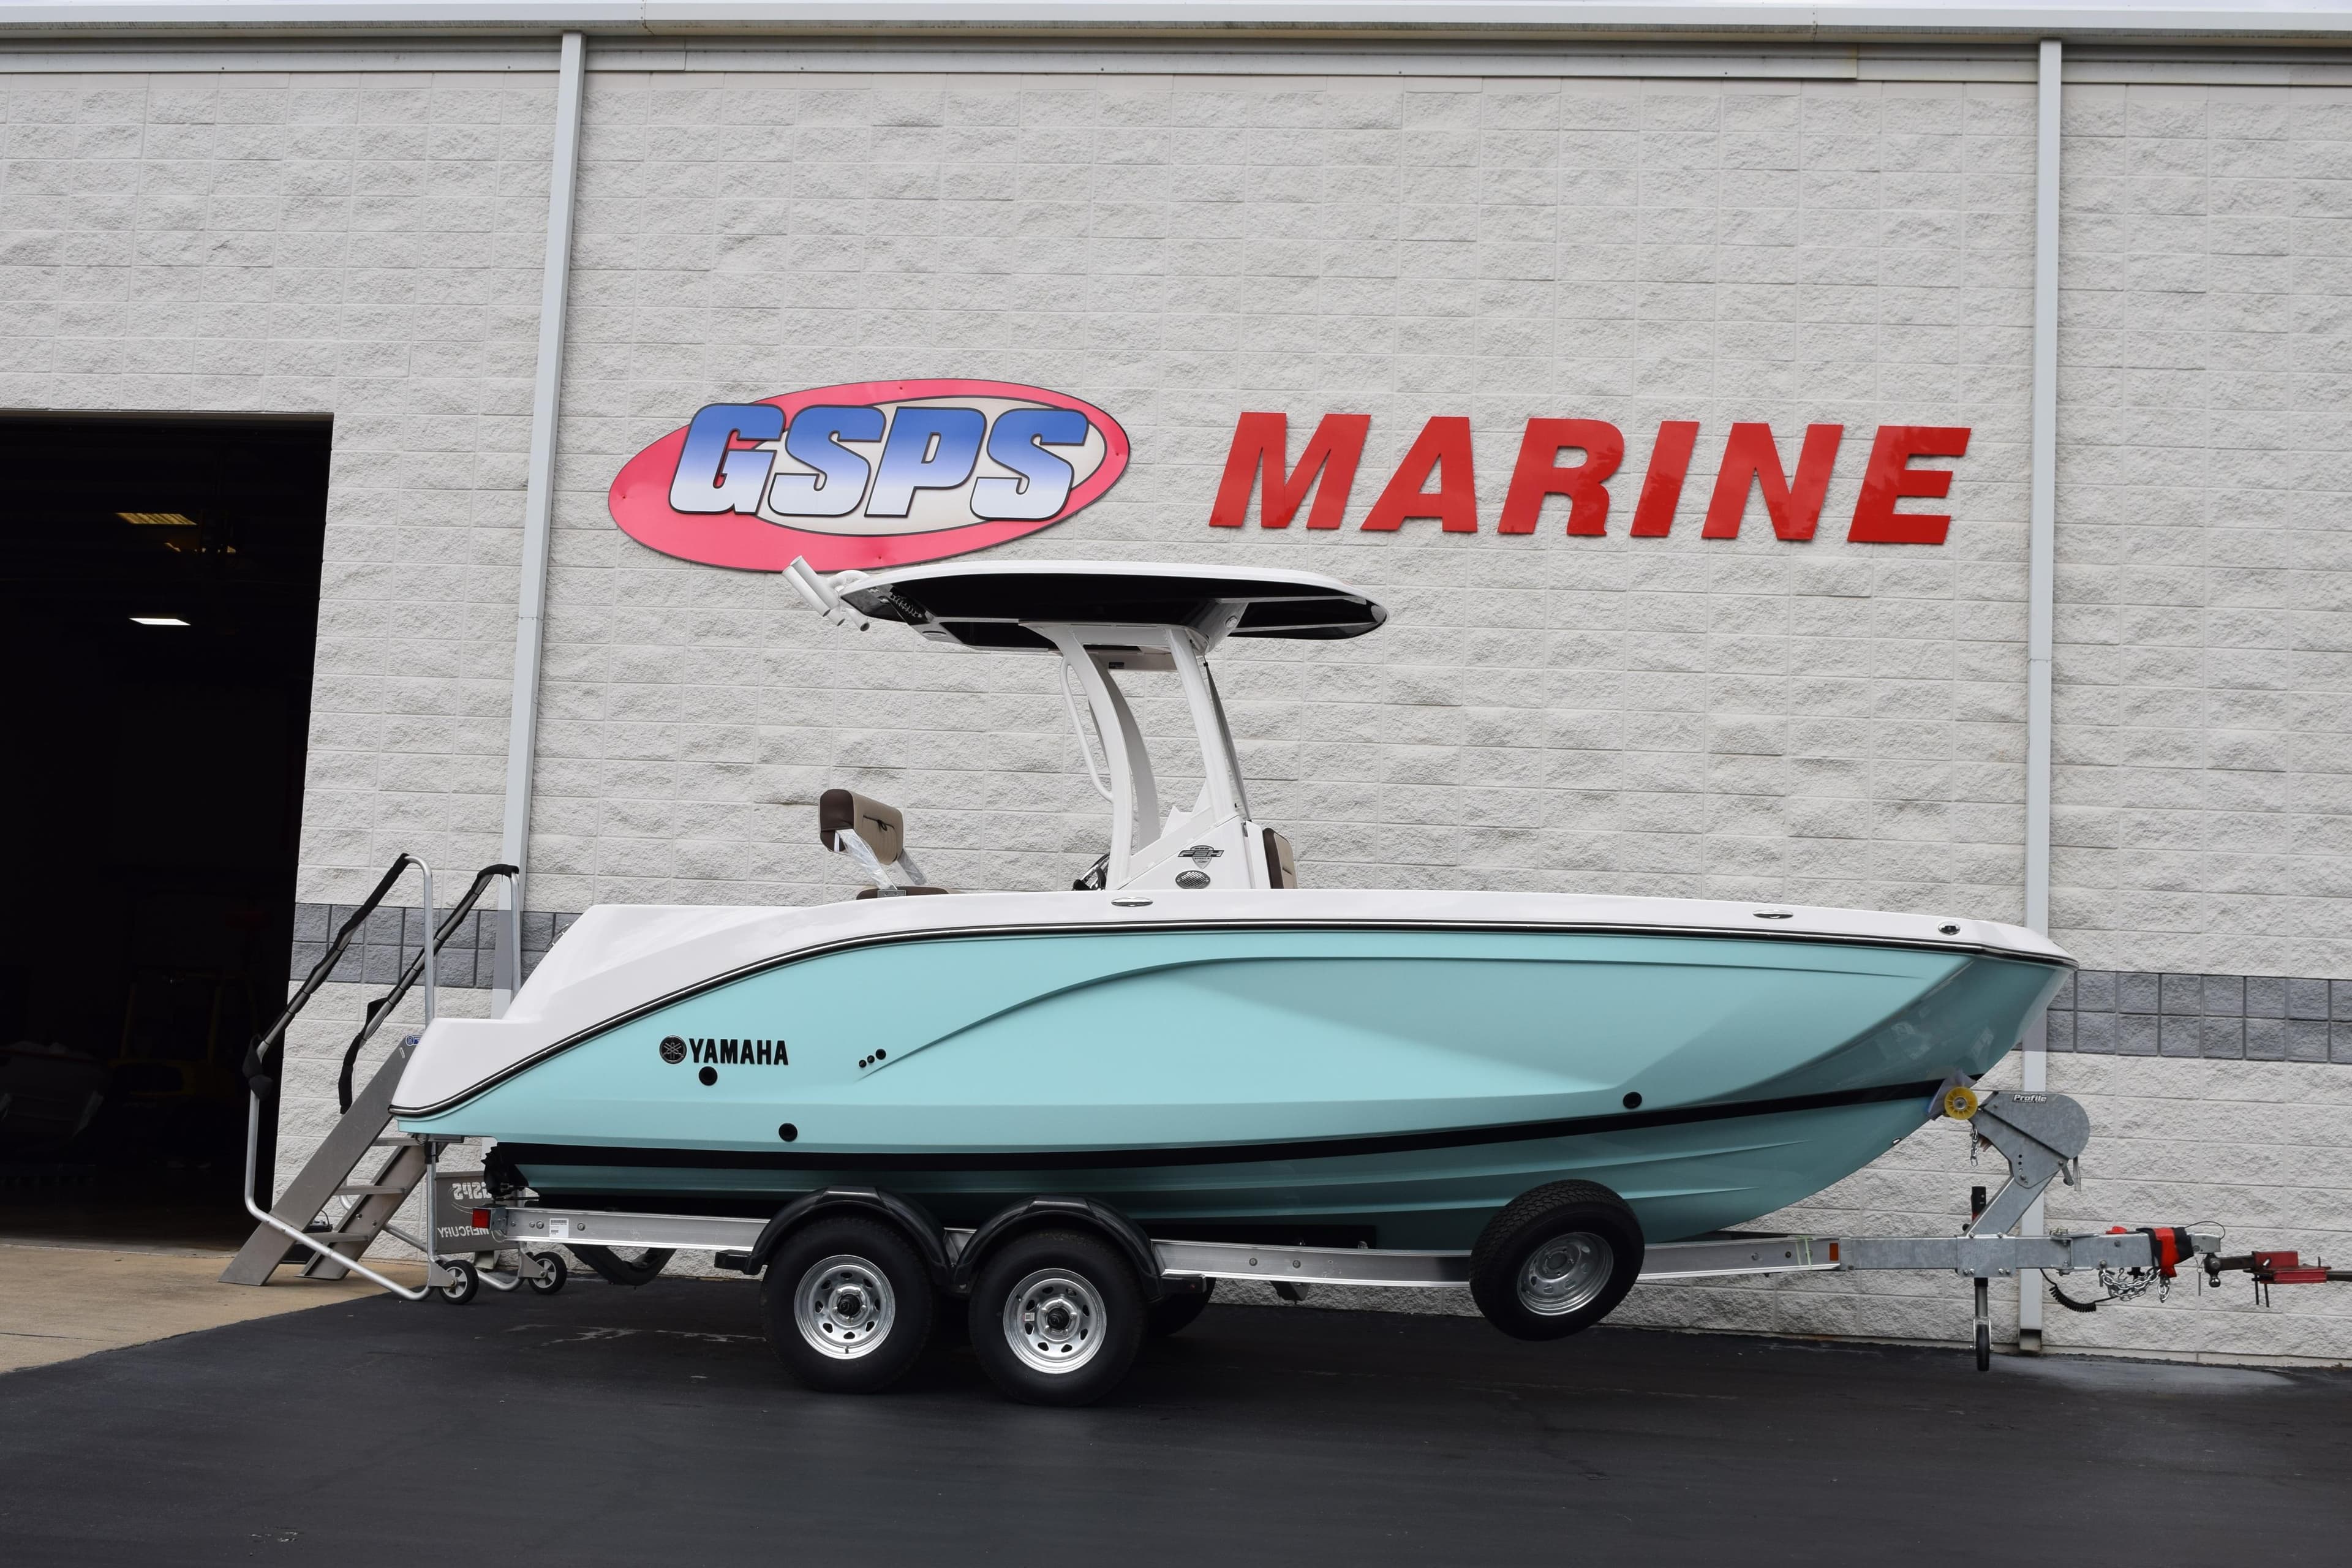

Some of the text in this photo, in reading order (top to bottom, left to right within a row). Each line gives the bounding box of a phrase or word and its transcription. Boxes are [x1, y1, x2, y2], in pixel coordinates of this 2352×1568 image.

[668, 402, 1972, 545] GSPS MARINE
[689, 1038, 789, 1066] YAMAHA
